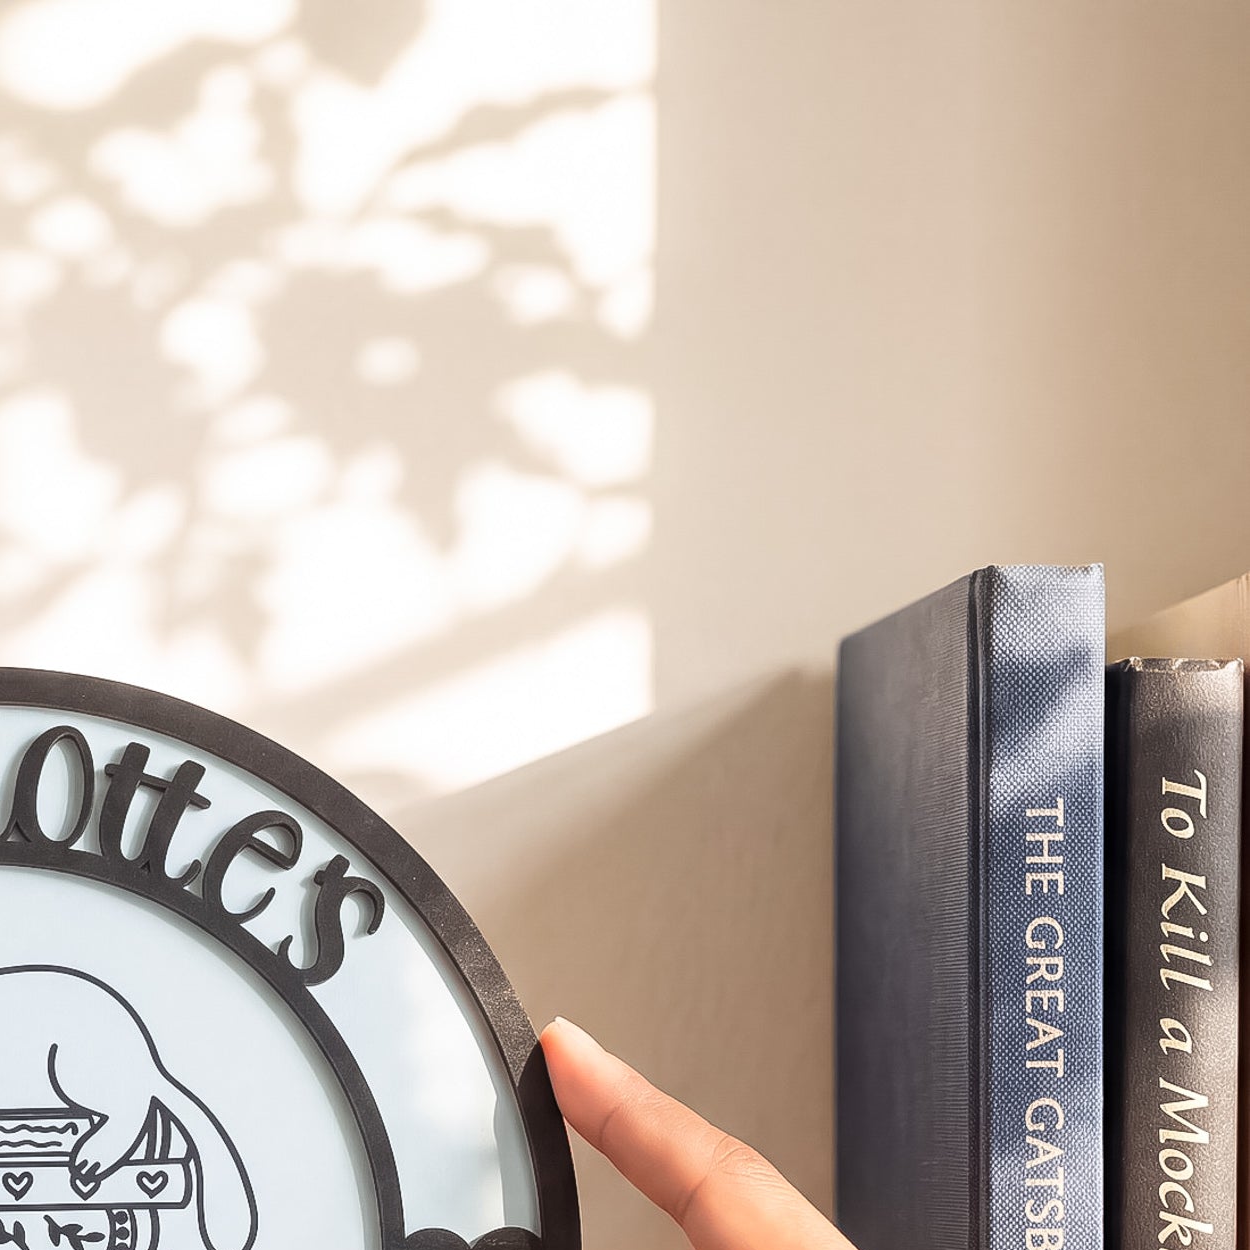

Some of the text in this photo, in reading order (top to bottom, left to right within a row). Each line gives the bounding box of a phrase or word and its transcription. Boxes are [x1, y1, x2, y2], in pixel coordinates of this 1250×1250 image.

[1025, 799, 1064, 895] THE
[1161, 770, 1207, 840] To
[1161, 863, 1211, 993] Kill
[1025, 916, 1065, 1078] GREAT
[1159, 1016, 1193, 1056] a
